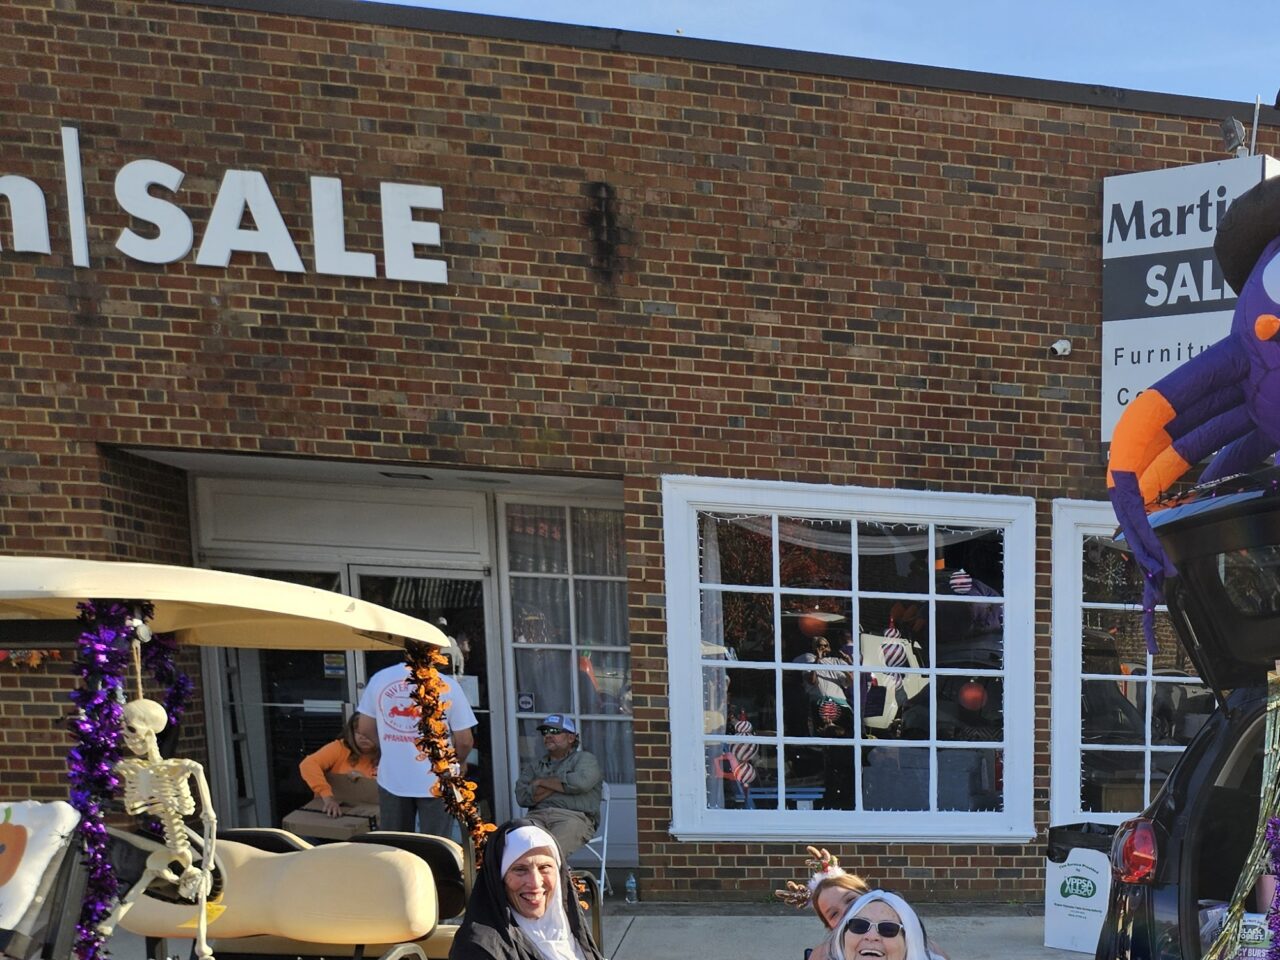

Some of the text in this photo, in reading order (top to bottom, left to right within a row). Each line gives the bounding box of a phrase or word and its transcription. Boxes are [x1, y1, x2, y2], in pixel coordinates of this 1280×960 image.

[115, 158, 448, 285] SALE
[1107, 185, 1236, 244] Marti
[1114, 342, 1211, 366] Furnit
